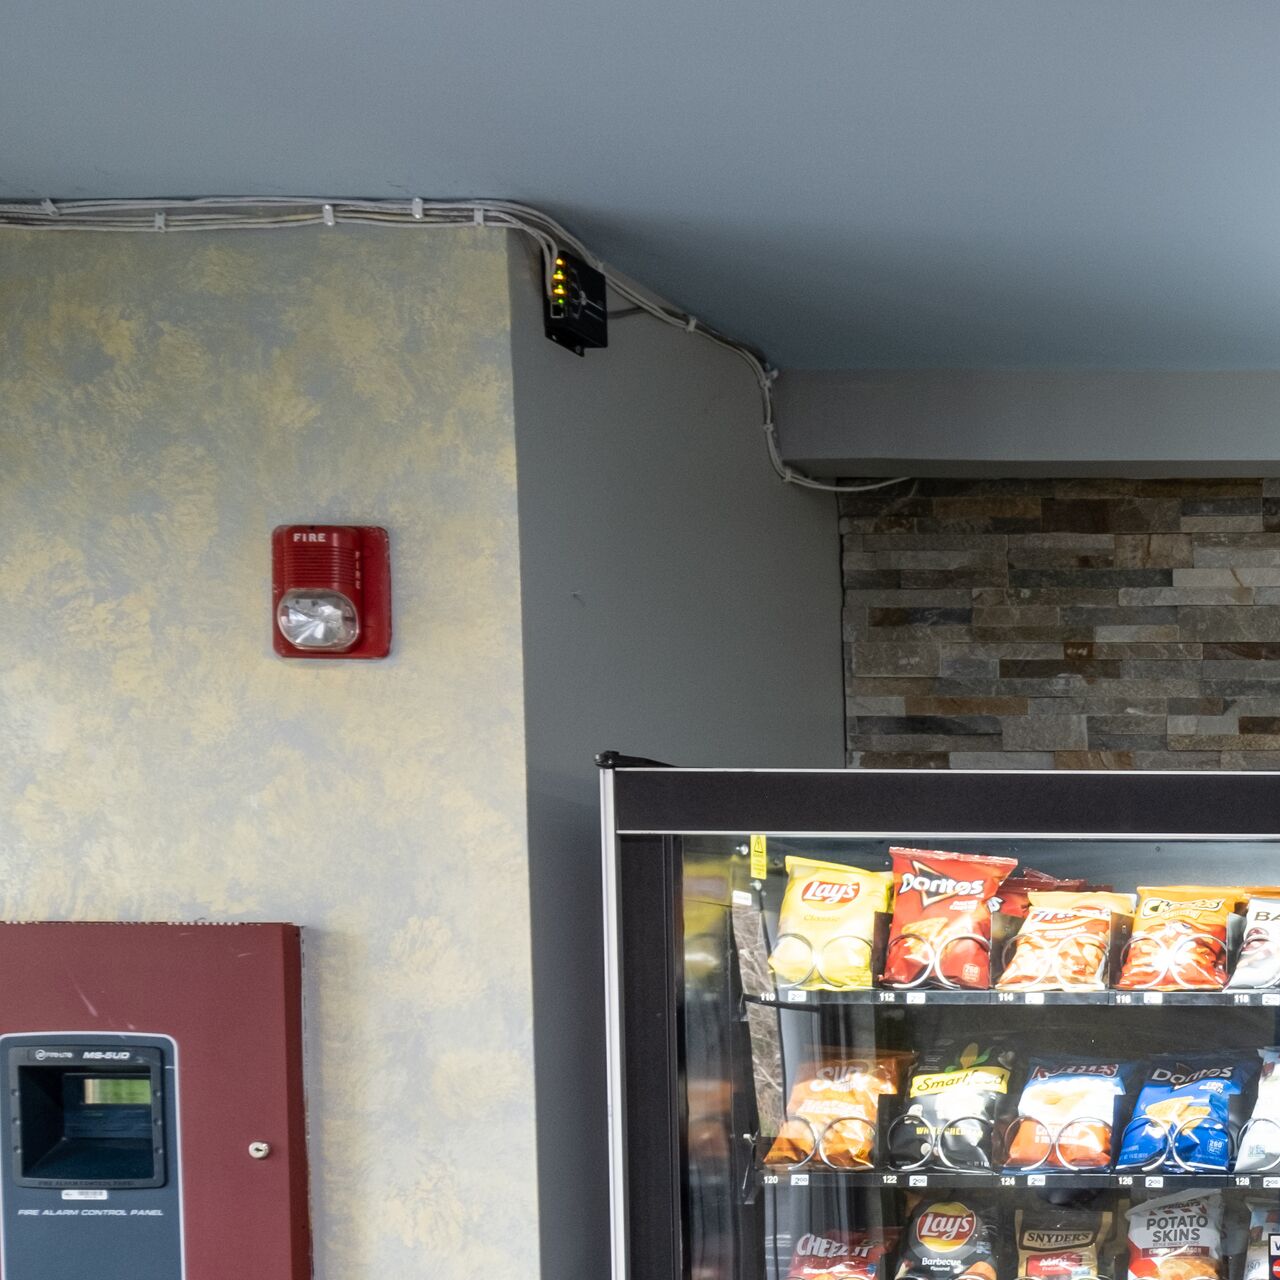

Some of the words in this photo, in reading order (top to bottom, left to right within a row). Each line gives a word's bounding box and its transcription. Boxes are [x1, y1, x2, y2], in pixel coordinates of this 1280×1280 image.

[293, 533, 327, 542] FIRE
[900, 872, 984, 895] Doritos
[1152, 1066, 1234, 1084] Doritos
[764, 1176, 778, 1184] 120
[882, 1175, 897, 1184] 122
[1001, 1177, 1015, 1185] 124
[920, 1212, 972, 1241] Lay's
[1146, 1215, 1208, 1230] POTATO
[1026, 1231, 1092, 1243] SNYDER'S
[1152, 1228, 1200, 1242] SKINS
[922, 1257, 962, 1267] Barbecue
